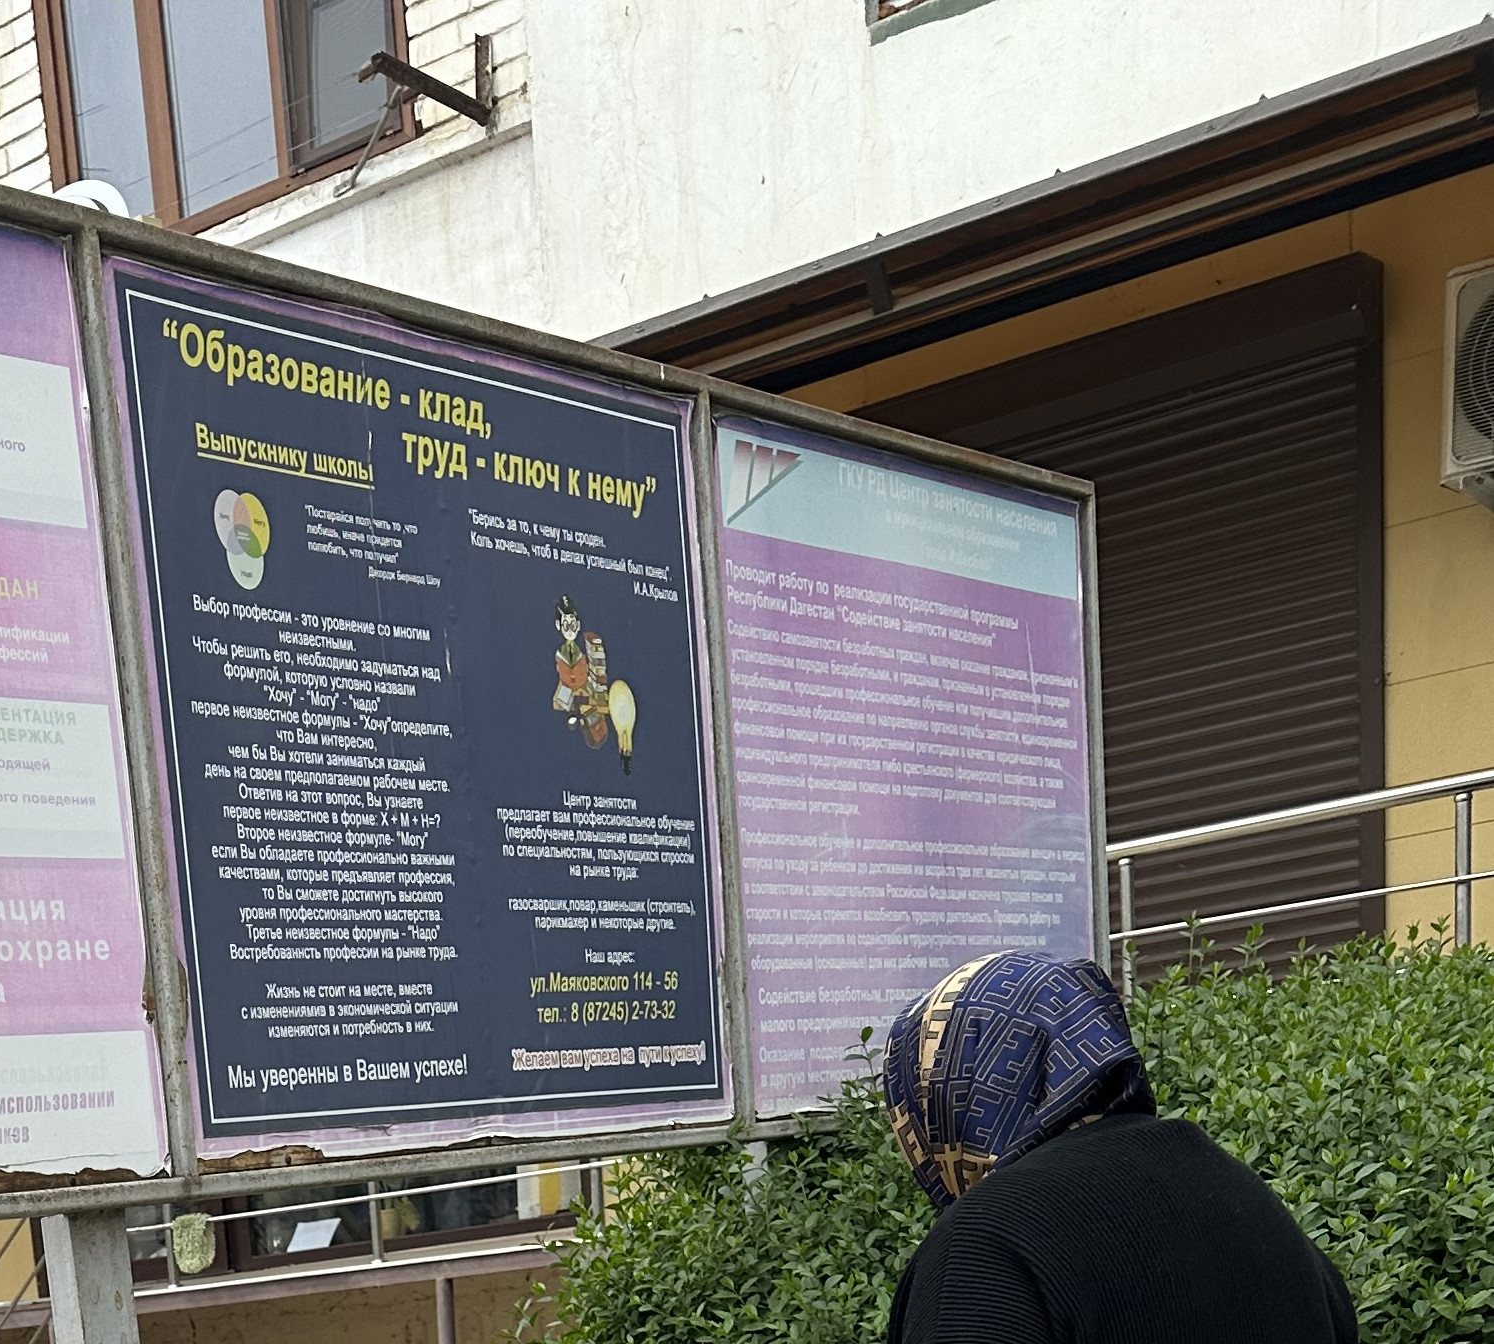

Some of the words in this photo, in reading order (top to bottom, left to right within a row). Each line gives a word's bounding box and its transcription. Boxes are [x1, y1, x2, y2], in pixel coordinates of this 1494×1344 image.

[418, 388, 491, 440] клад,
[195, 422, 307, 473] Выпускнику
[312, 452, 373, 482] школы
[401, 432, 468, 481] труд
[493, 451, 559, 492] ключ
[567, 467, 581, 497] к
[192, 593, 230, 618] Выбор
[232, 603, 292, 624] профессии
[300, 613, 319, 628] это
[376, 623, 391, 637] со
[392, 625, 430, 641] многим
[192, 635, 228, 656] Чтобы
[230, 643, 271, 661] решить
[273, 649, 294, 666] его,
[296, 651, 359, 672] необходимо
[360, 659, 420, 678] задуматься
[421, 666, 441, 682] над
[223, 660, 283, 685] формулой,
[284, 670, 328, 690] которую
[329, 676, 372, 693] условно
[373, 680, 416, 696] назвали
[275, 729, 295, 743] что
[296, 727, 319, 745] Вам
[320, 733, 377, 752] интересно,
[238, 782, 283, 801] Ответив
[284, 789, 299, 803] на
[300, 790, 322, 804] этот
[324, 792, 364, 809] вопрос,
[365, 791, 382, 807] Вы
[383, 795, 423, 811] узнаете
[211, 845, 238, 859] если
[239, 843, 257, 860] Вы
[258, 844, 315, 863] обладаете
[316, 848, 409, 866] профессионально
[410, 853, 455, 866] важными
[218, 865, 284, 883] качествами,
[285, 868, 329, 885] которые
[330, 869, 396, 885] предъявляет
[397, 868, 455, 887] профессия,
[238, 906, 277, 923] уровня
[278, 904, 382, 923] профессионального
[584, 948, 605, 963] Наш
[632, 970, 653, 990] 114
[663, 970, 678, 991] 56
[570, 1001, 579, 1022] 8
[582, 1000, 629, 1026] (87245)
[631, 999, 676, 1020] 2-73-32
[227, 1064, 256, 1089] Мы
[259, 1065, 339, 1093] уверенны
[342, 1064, 353, 1082] в
[356, 1058, 410, 1081] Вашем
[413, 1053, 468, 1083] успехе!
